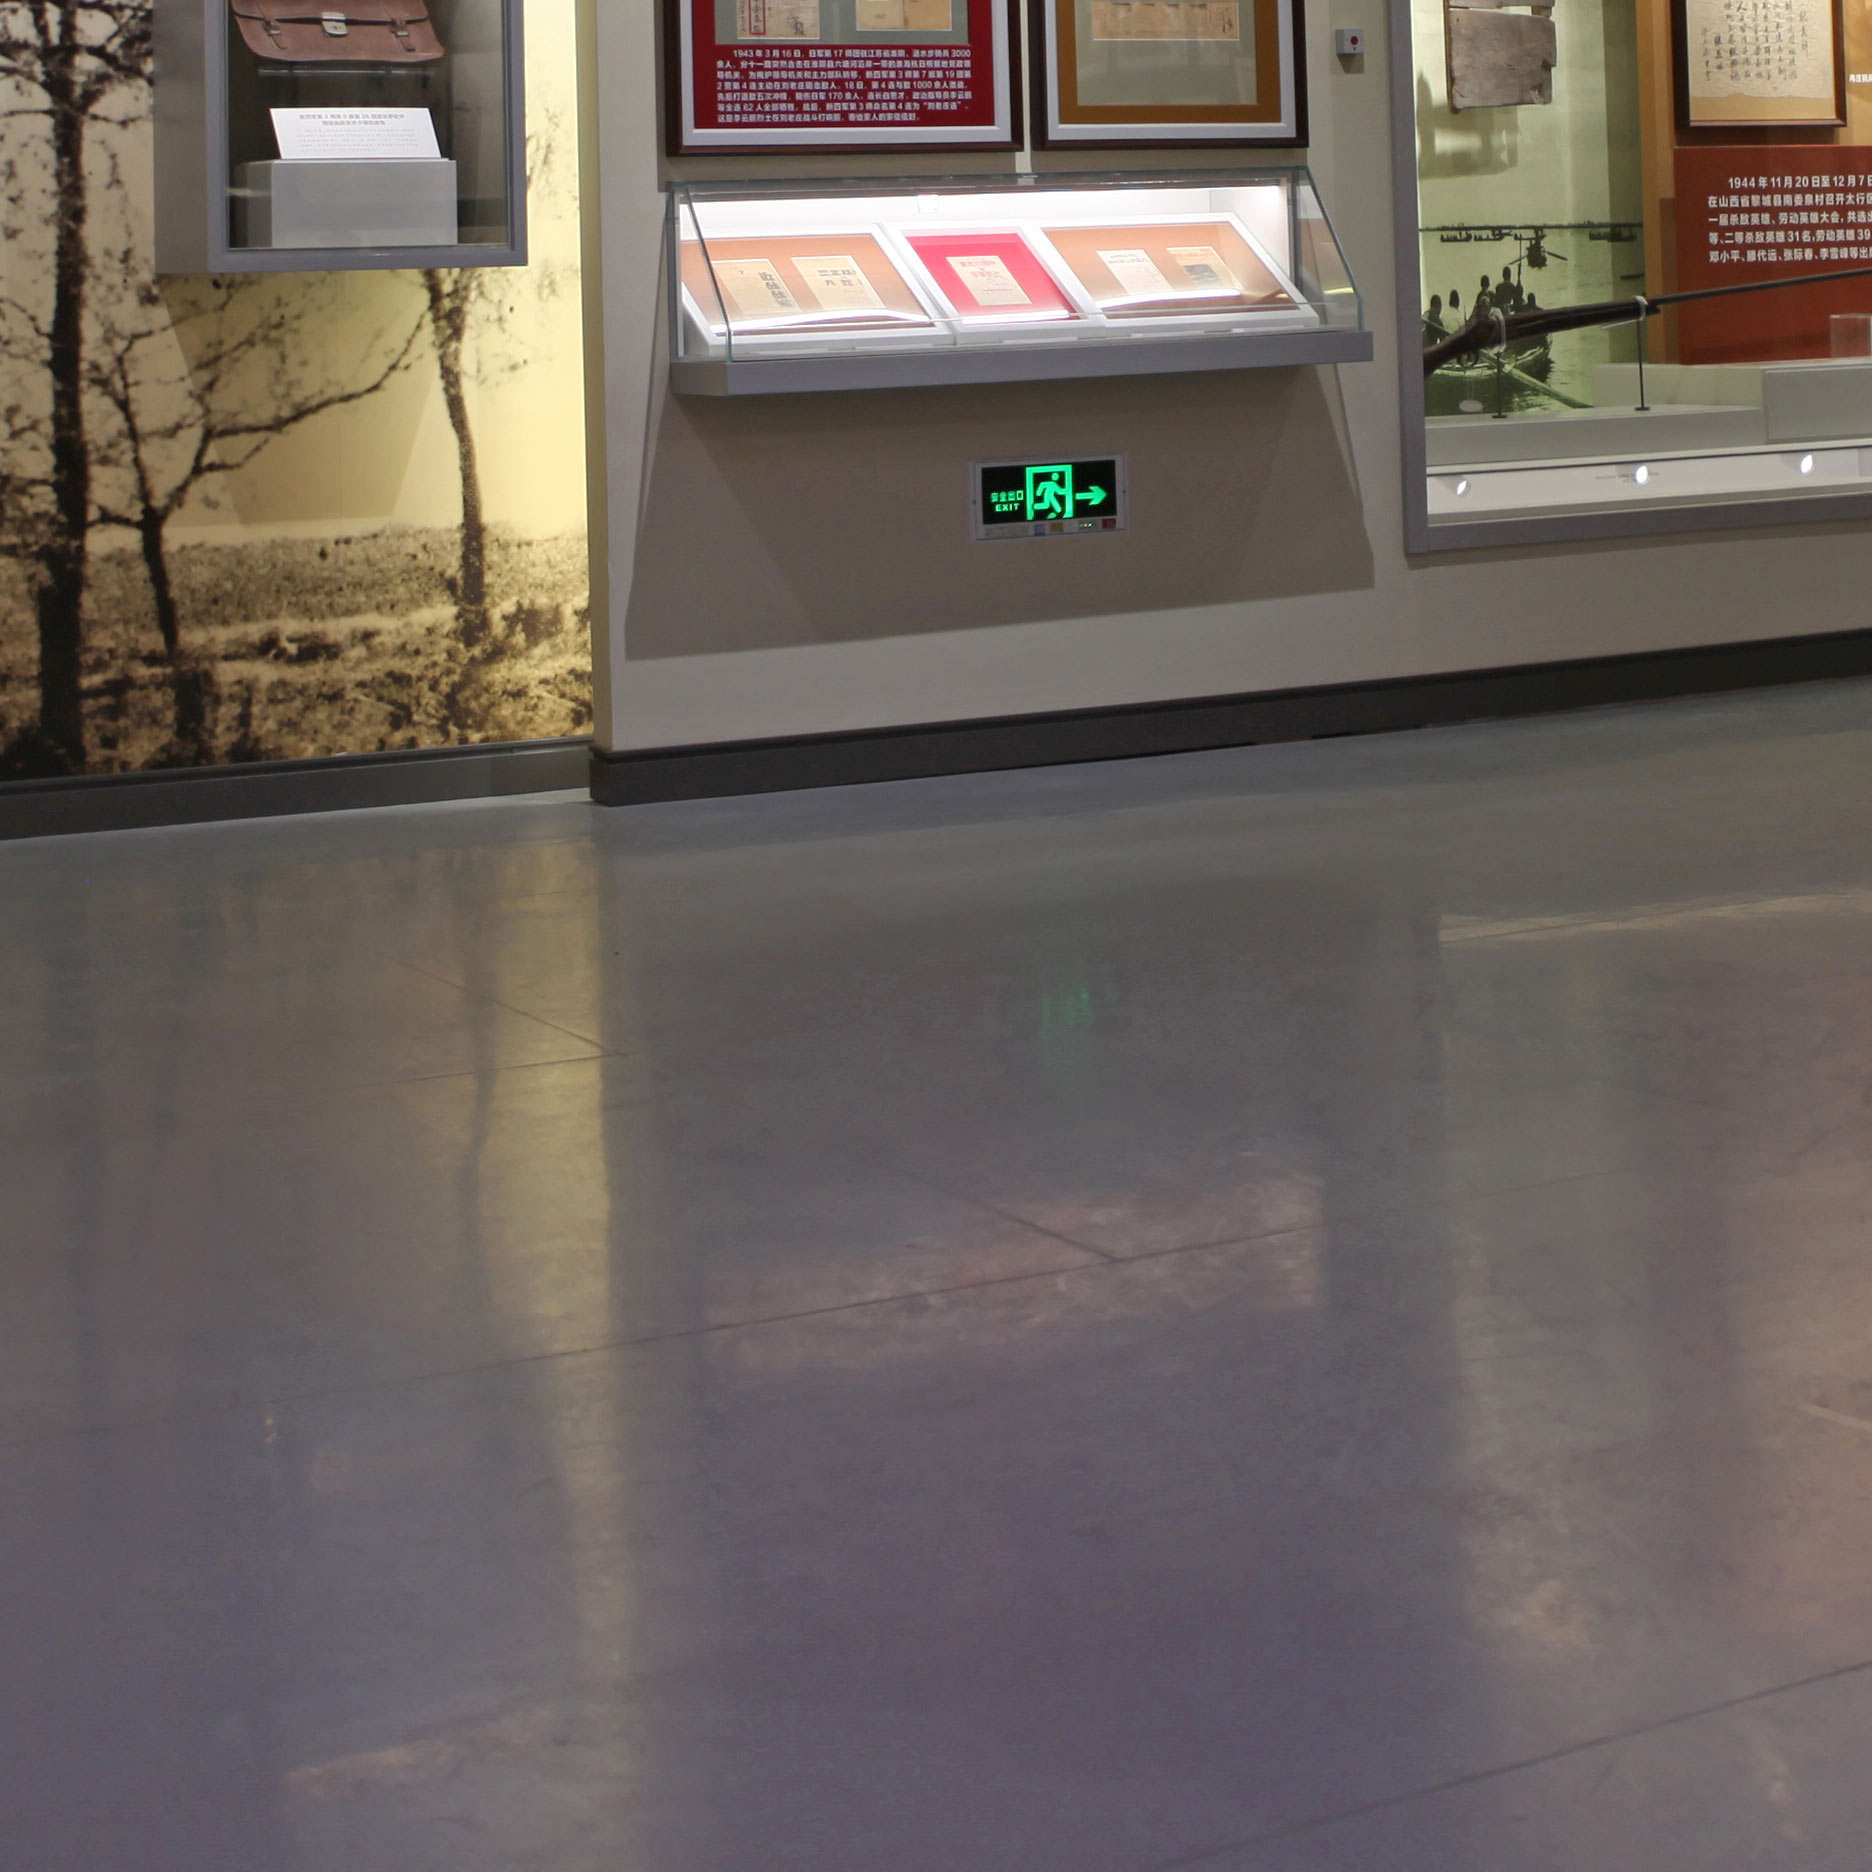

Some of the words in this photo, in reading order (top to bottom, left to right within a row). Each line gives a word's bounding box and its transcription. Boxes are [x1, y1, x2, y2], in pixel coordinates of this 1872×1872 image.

[991, 490, 1024, 502] 安全出口
[995, 503, 1020, 512] EXIT
